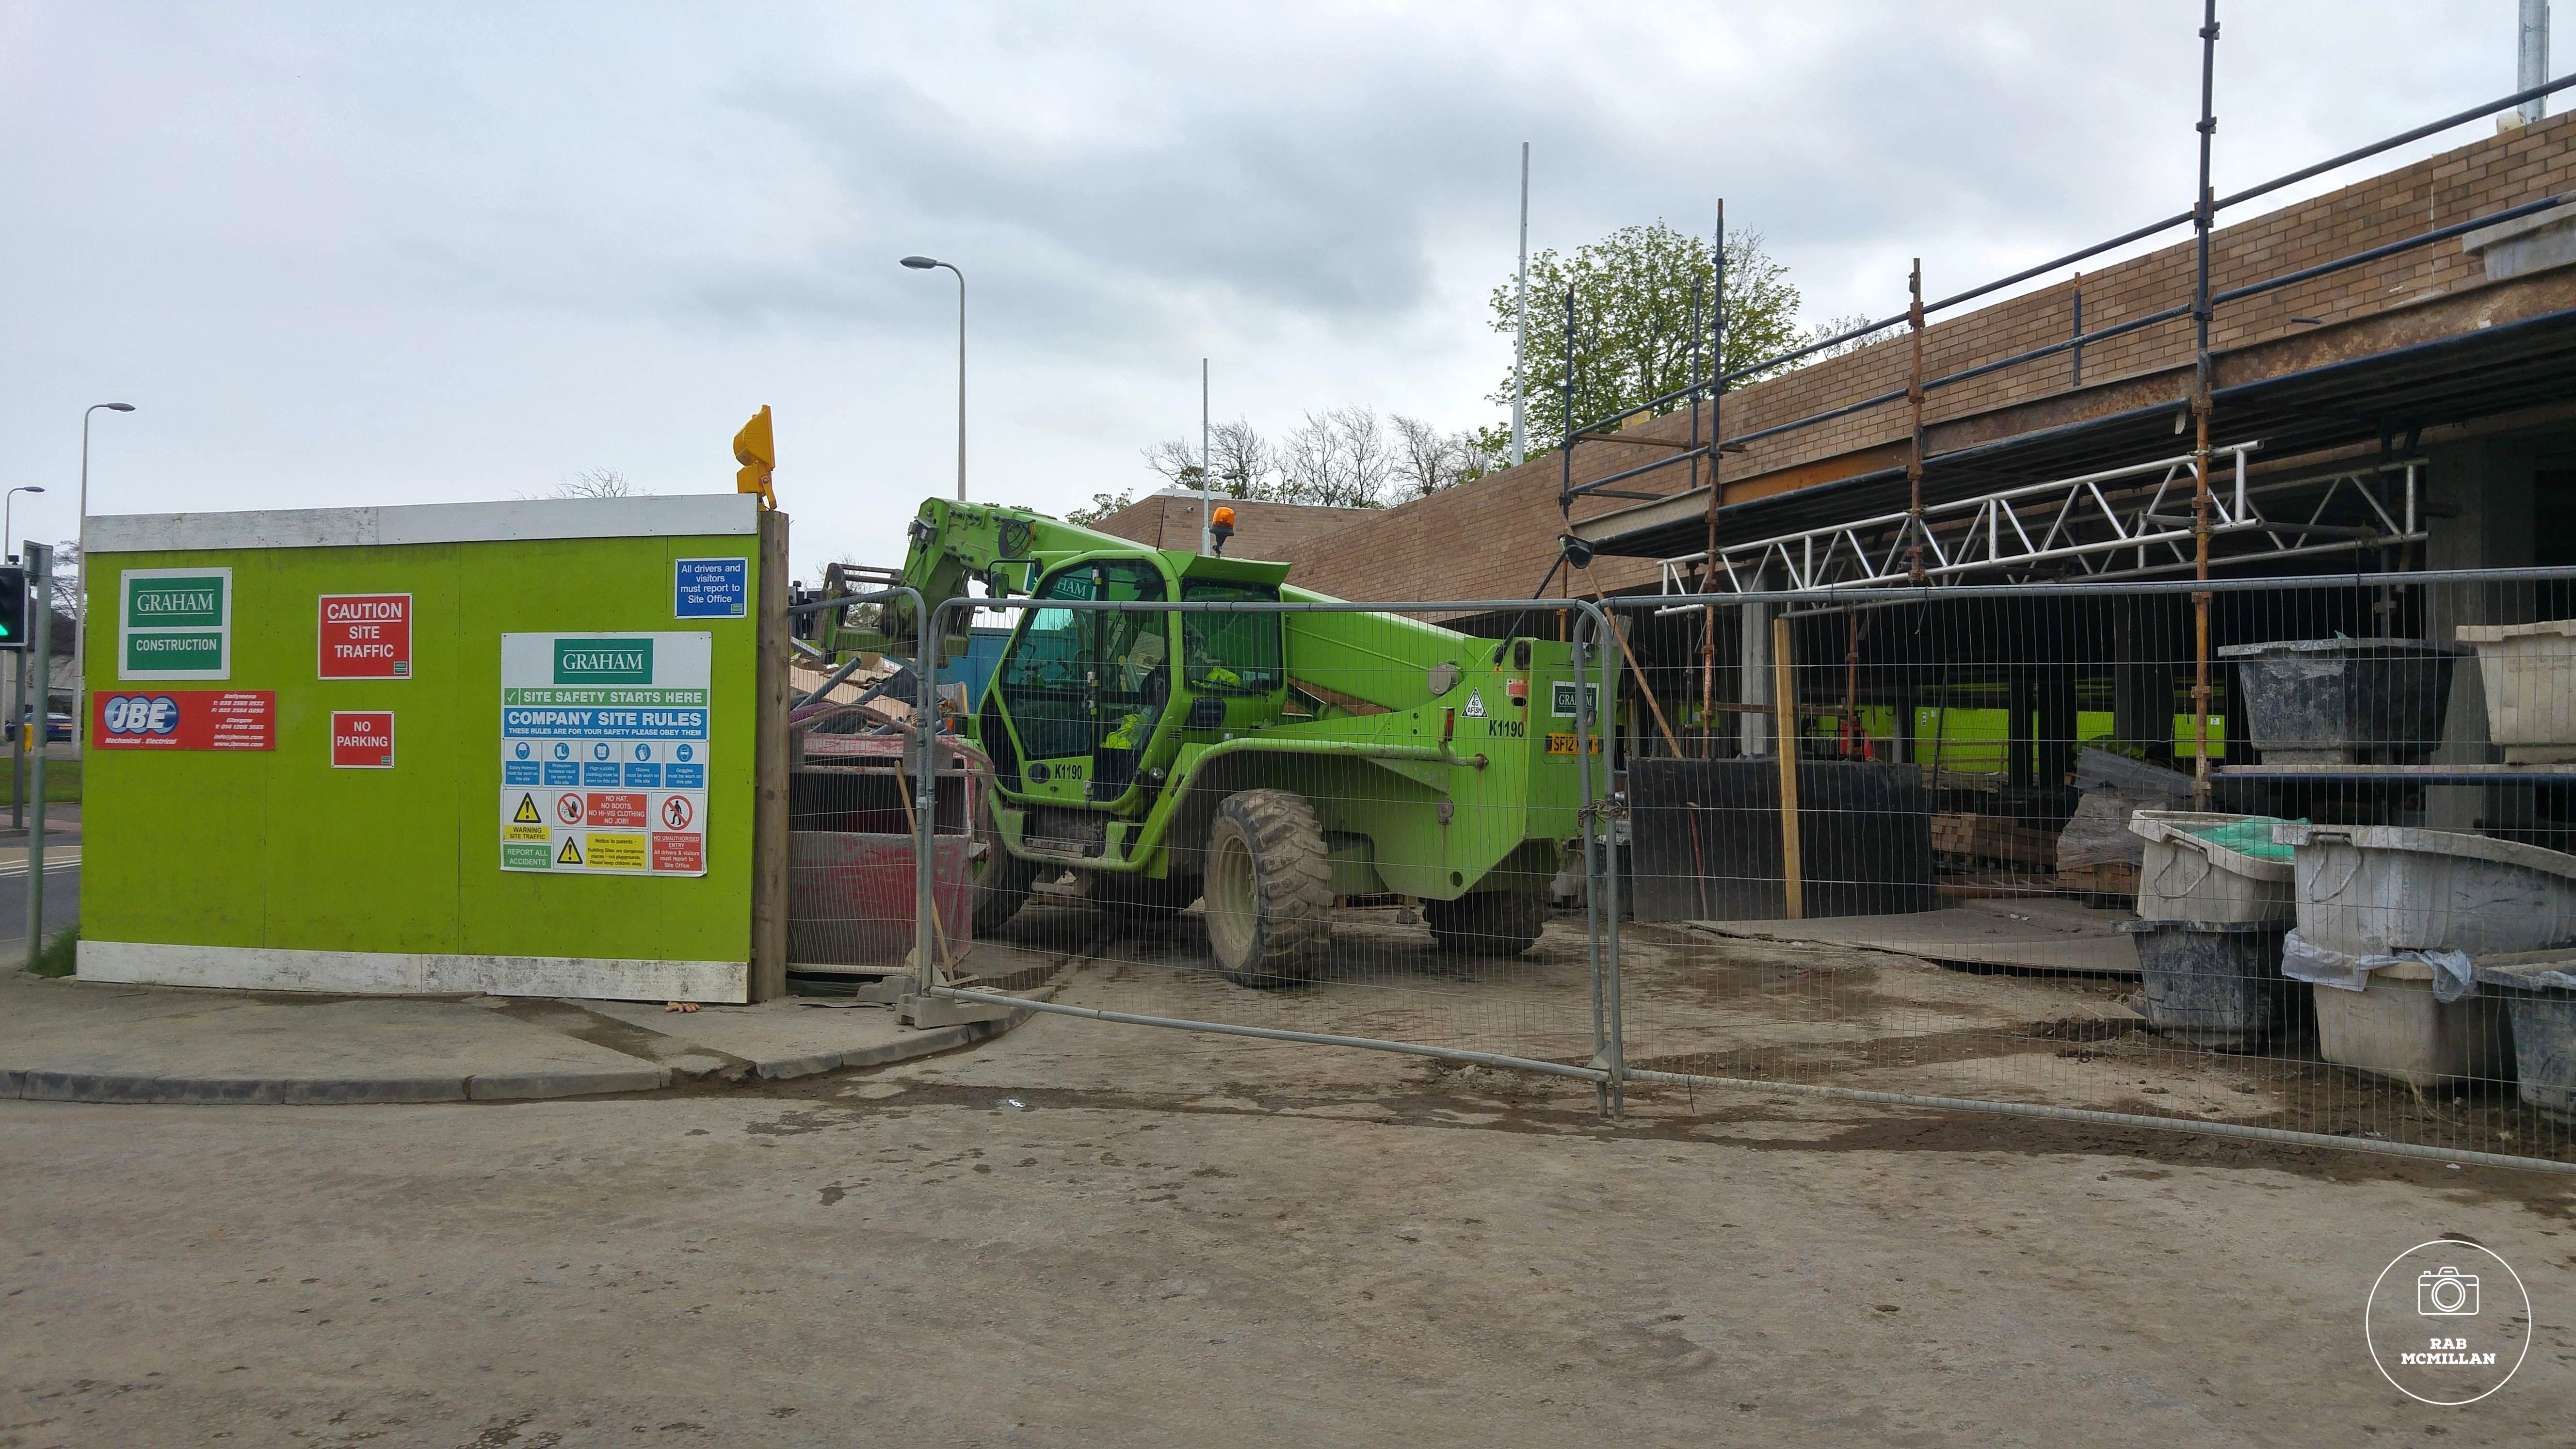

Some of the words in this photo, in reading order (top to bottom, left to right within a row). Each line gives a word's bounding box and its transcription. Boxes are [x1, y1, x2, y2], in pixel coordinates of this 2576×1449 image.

[694, 564, 722, 573] drivers
[704, 584, 728, 594] report
[137, 593, 214, 612] GRAHAM
[688, 595, 704, 603] Site
[707, 595, 732, 603] Office
[327, 603, 402, 619] CAUTION
[349, 626, 380, 639] SITE
[136, 639, 217, 651] CONSTRUCTION
[335, 644, 394, 658] TRAFFIC
[563, 654, 643, 670] GRAHAM
[524, 692, 551, 702] SITE
[556, 692, 606, 702] SAFETY
[611, 692, 660, 703] STARTS
[665, 692, 702, 703] HERE
[1559, 694, 1592, 706] GRAM
[112, 703, 168, 728] JBE
[508, 711, 592, 725] COMPANY
[598, 712, 637, 725] SITE
[642, 713, 701, 726] RULES
[354, 721, 371, 732] NO
[1489, 720, 1524, 738] K1190
[337, 736, 388, 747] PARKING
[1554, 737, 1574, 751] SF12
[1055, 764, 1082, 780] K1190
